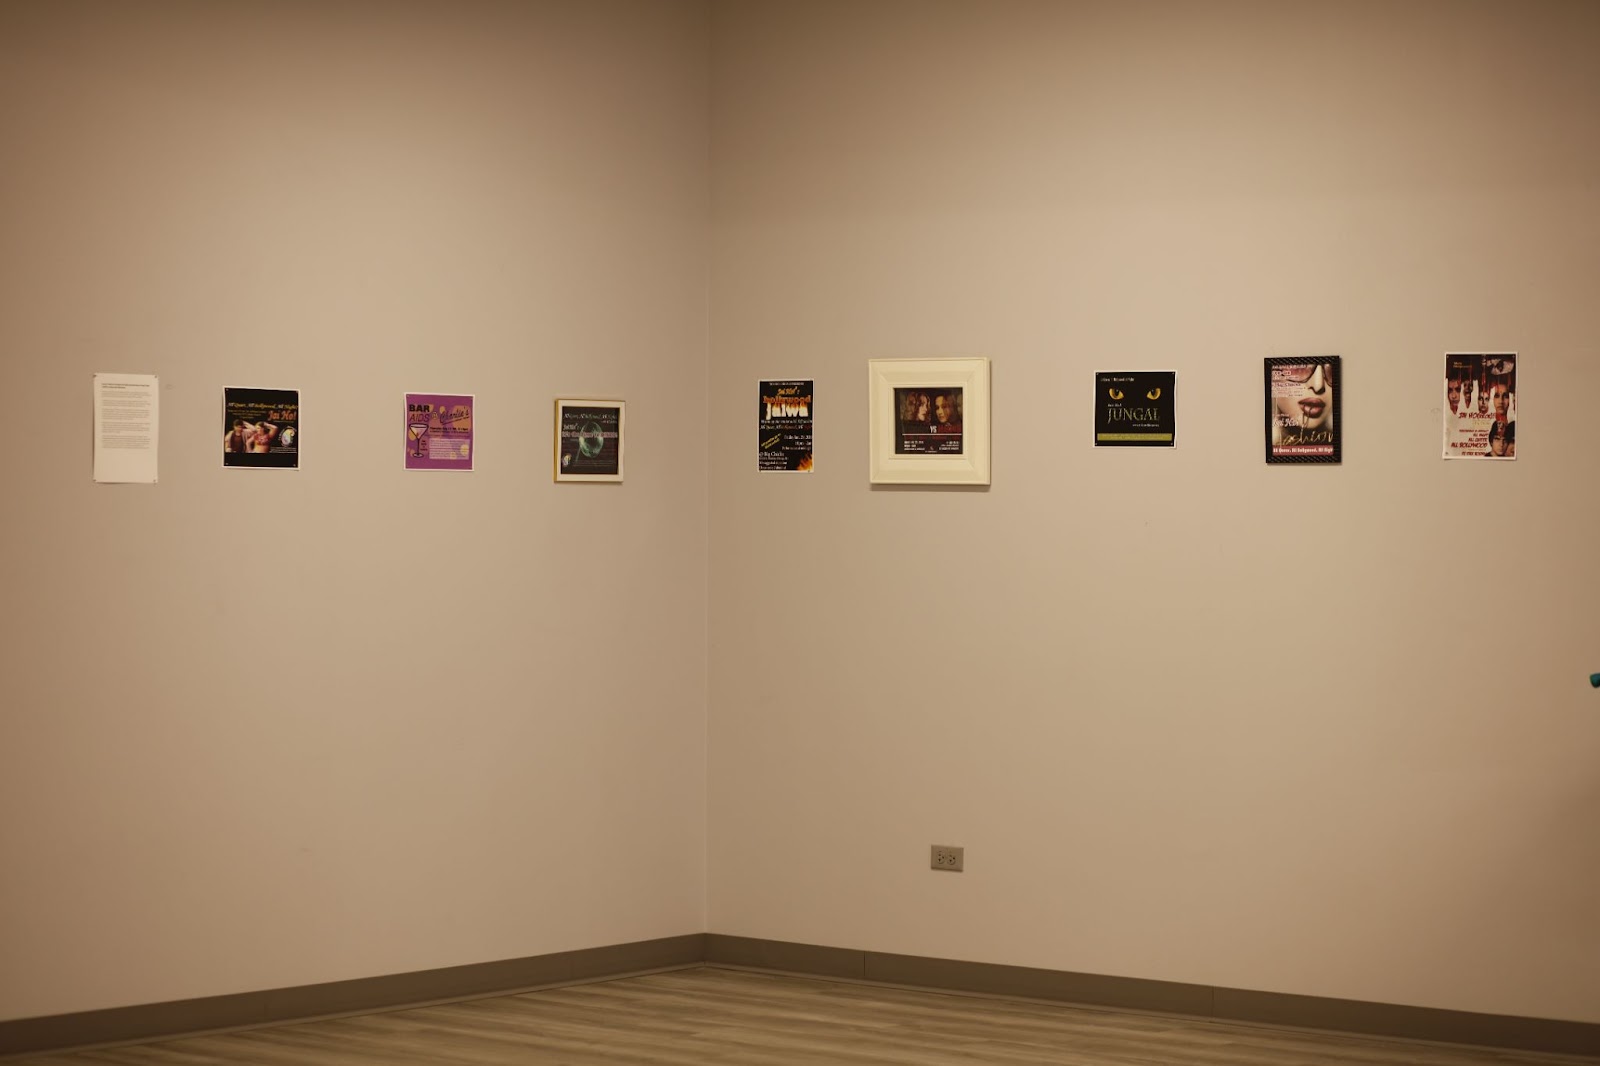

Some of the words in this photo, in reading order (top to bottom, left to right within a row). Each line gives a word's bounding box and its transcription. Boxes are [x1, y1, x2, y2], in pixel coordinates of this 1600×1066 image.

[409, 404, 430, 412] BAR
[410, 413, 430, 422] AIDS
[1107, 408, 1160, 424] JUNGAL
